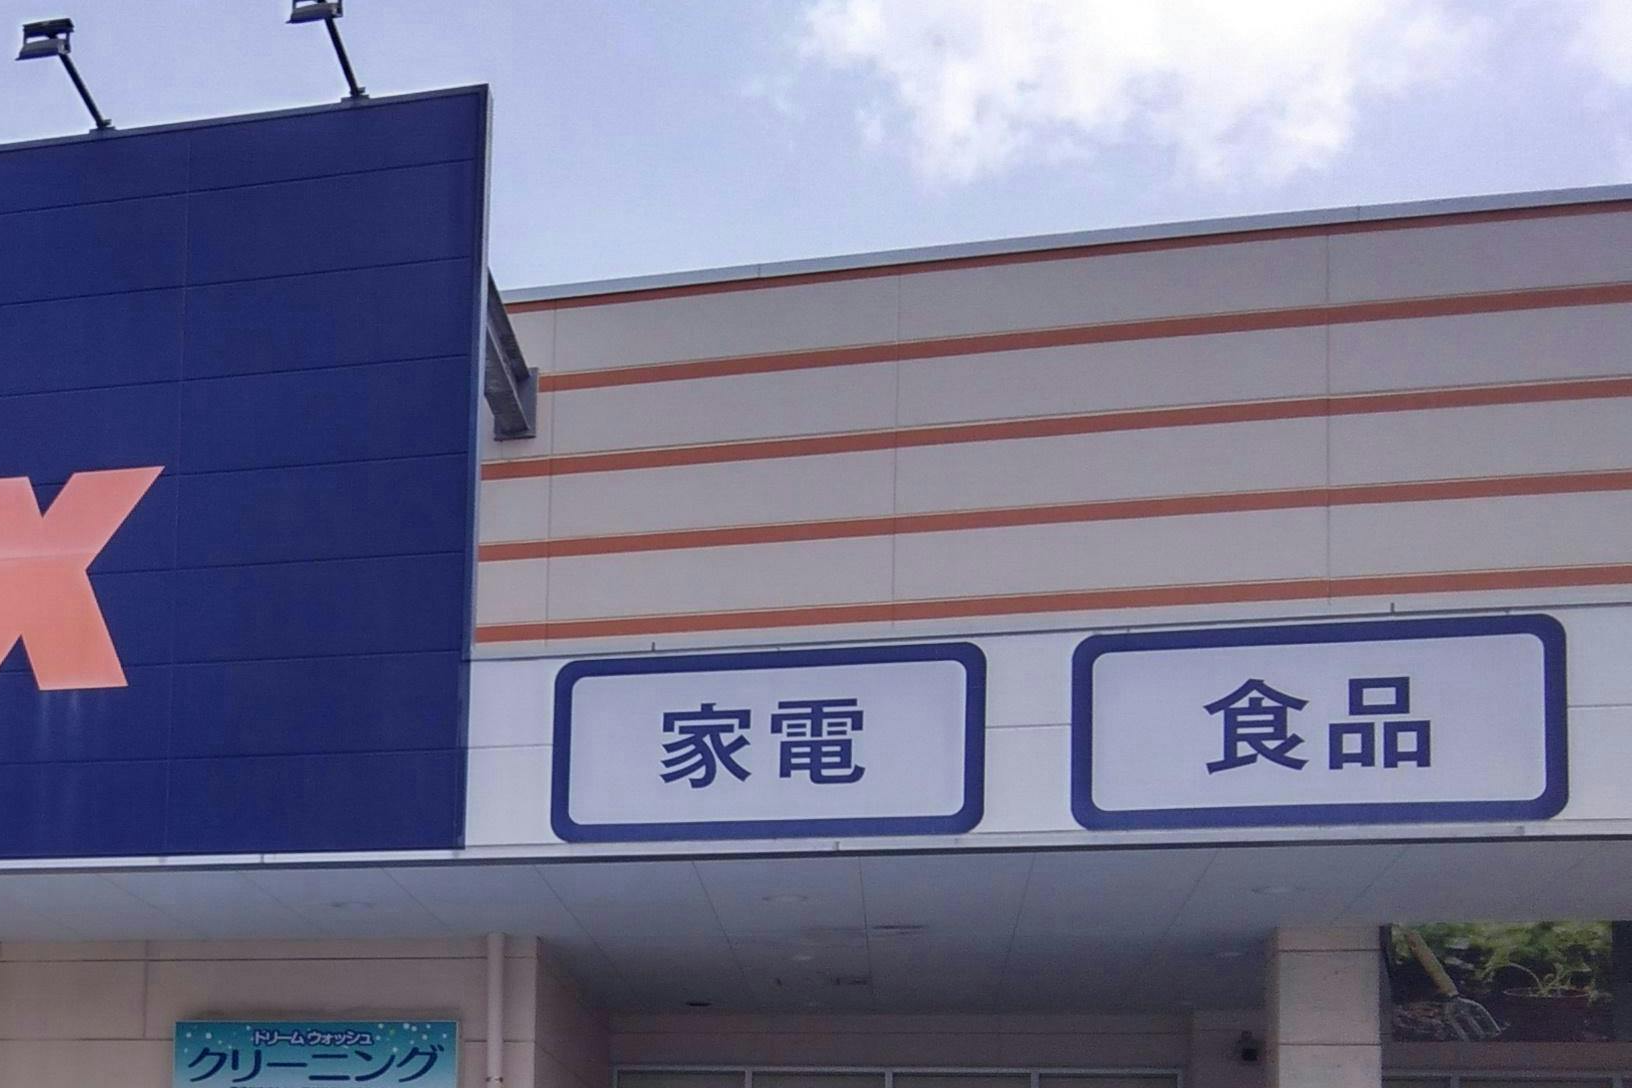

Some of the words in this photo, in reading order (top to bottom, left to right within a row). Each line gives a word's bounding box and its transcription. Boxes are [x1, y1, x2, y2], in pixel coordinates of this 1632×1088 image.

[658, 697, 868, 790] 家電
[1203, 674, 1434, 776] 食品
[187, 1045, 445, 1084] クリーニング
